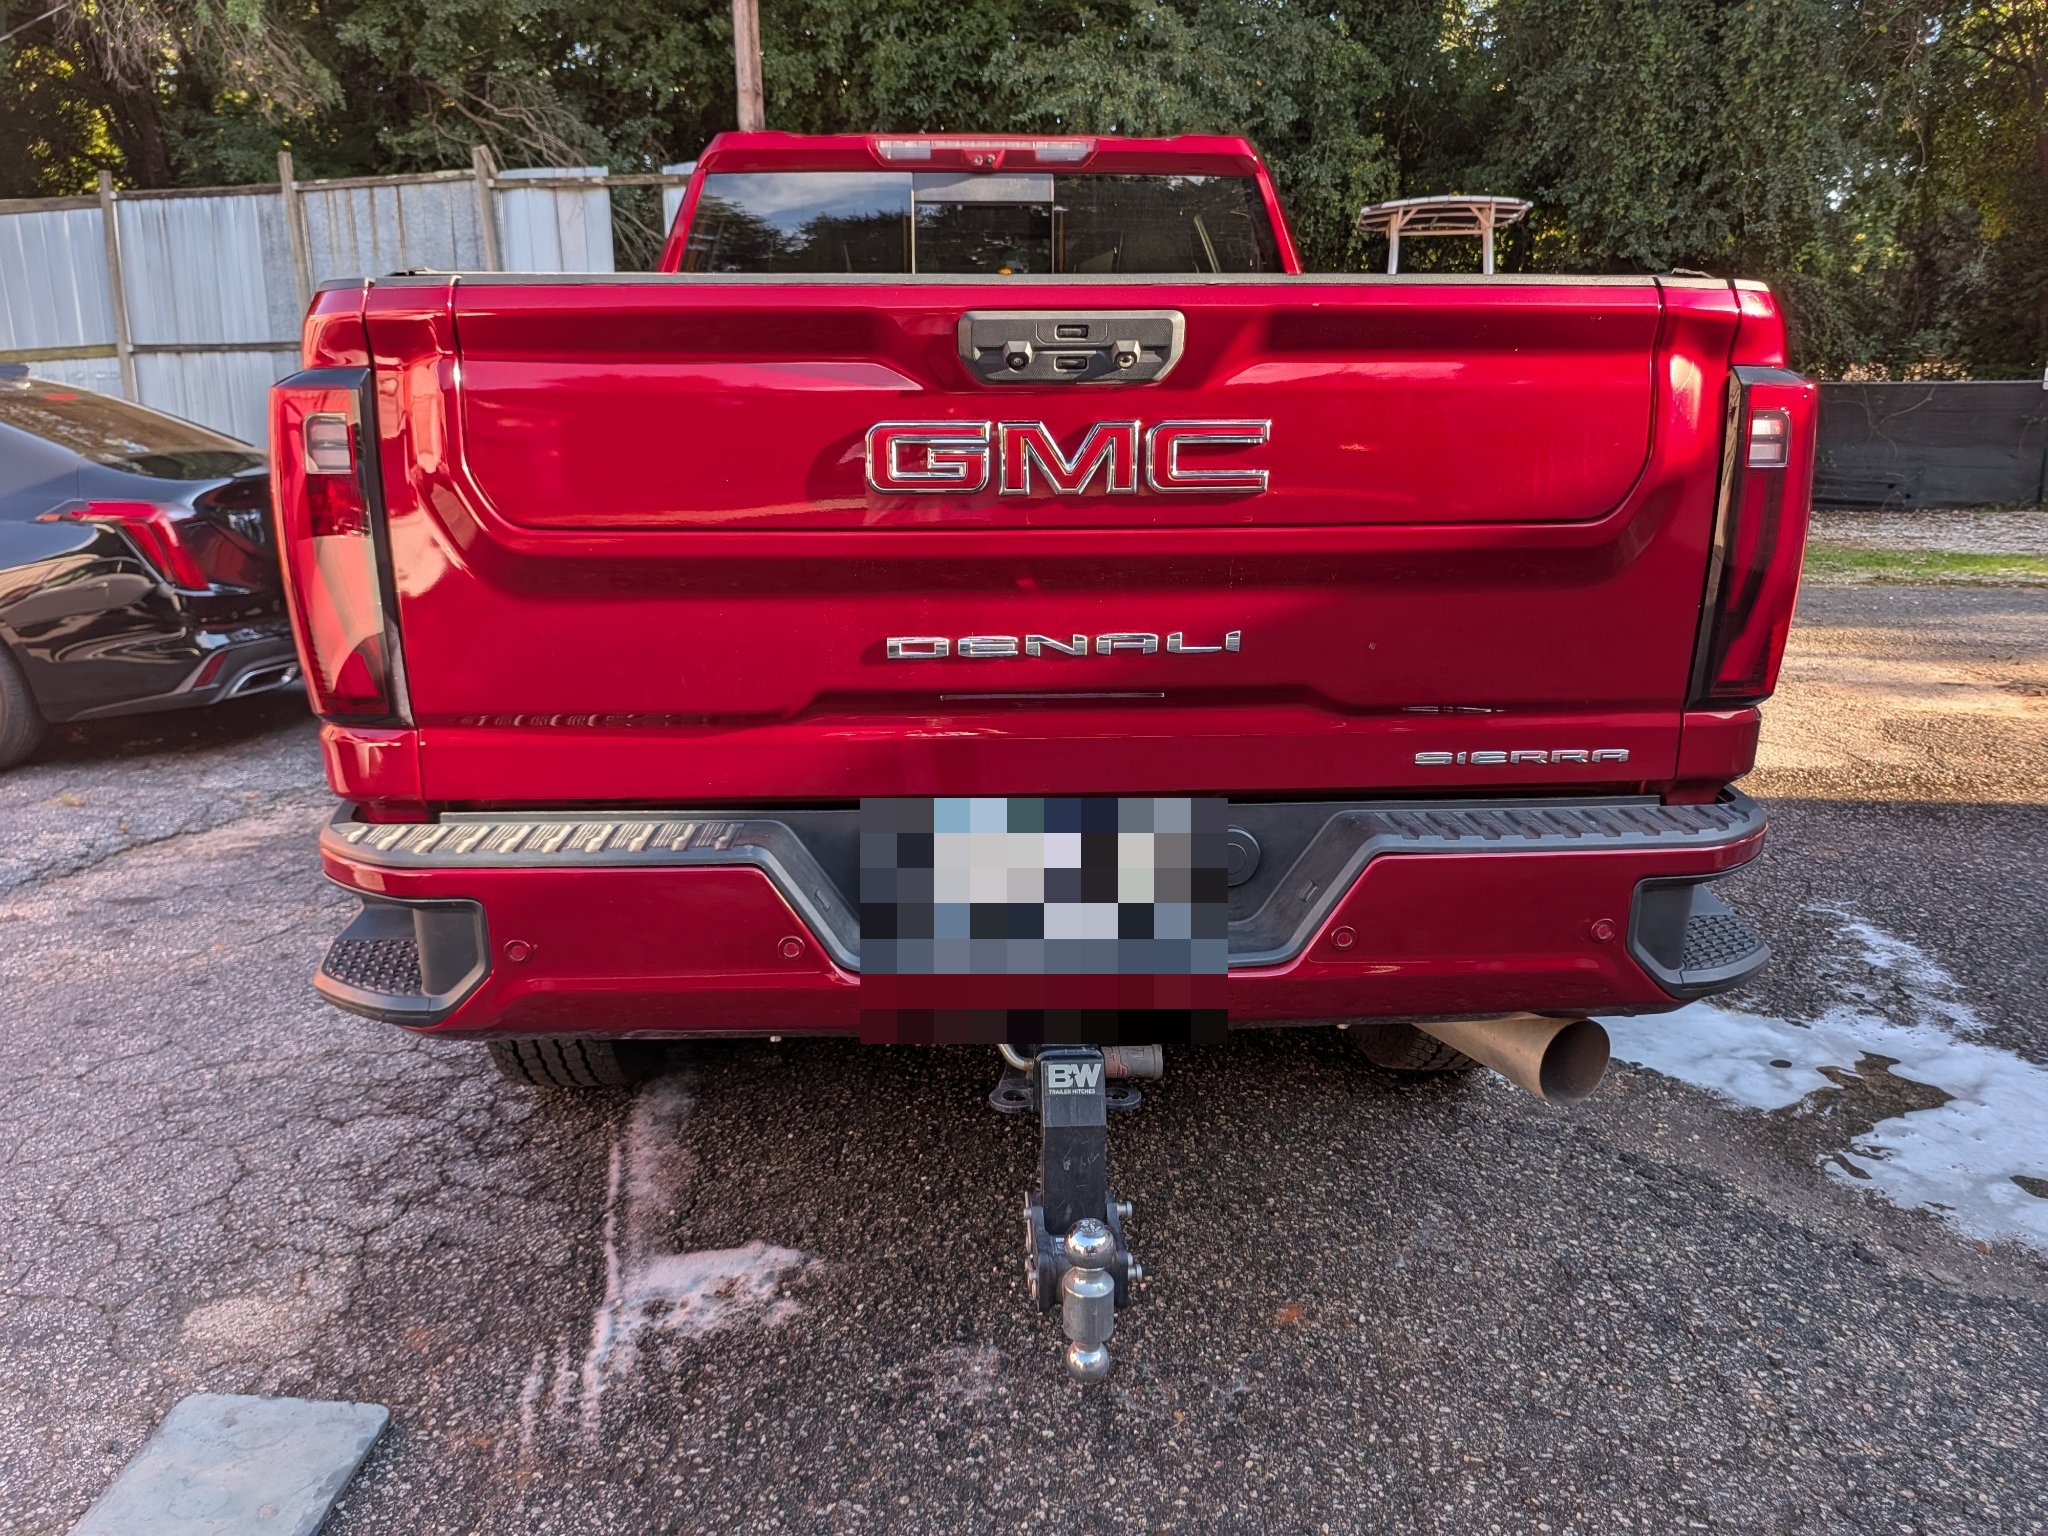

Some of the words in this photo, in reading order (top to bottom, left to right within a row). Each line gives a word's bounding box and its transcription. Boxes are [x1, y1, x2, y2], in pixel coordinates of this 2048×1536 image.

[865, 419, 1272, 495] GMC
[886, 630, 1241, 659] DENALI
[1414, 749, 1630, 765] SIERRA
